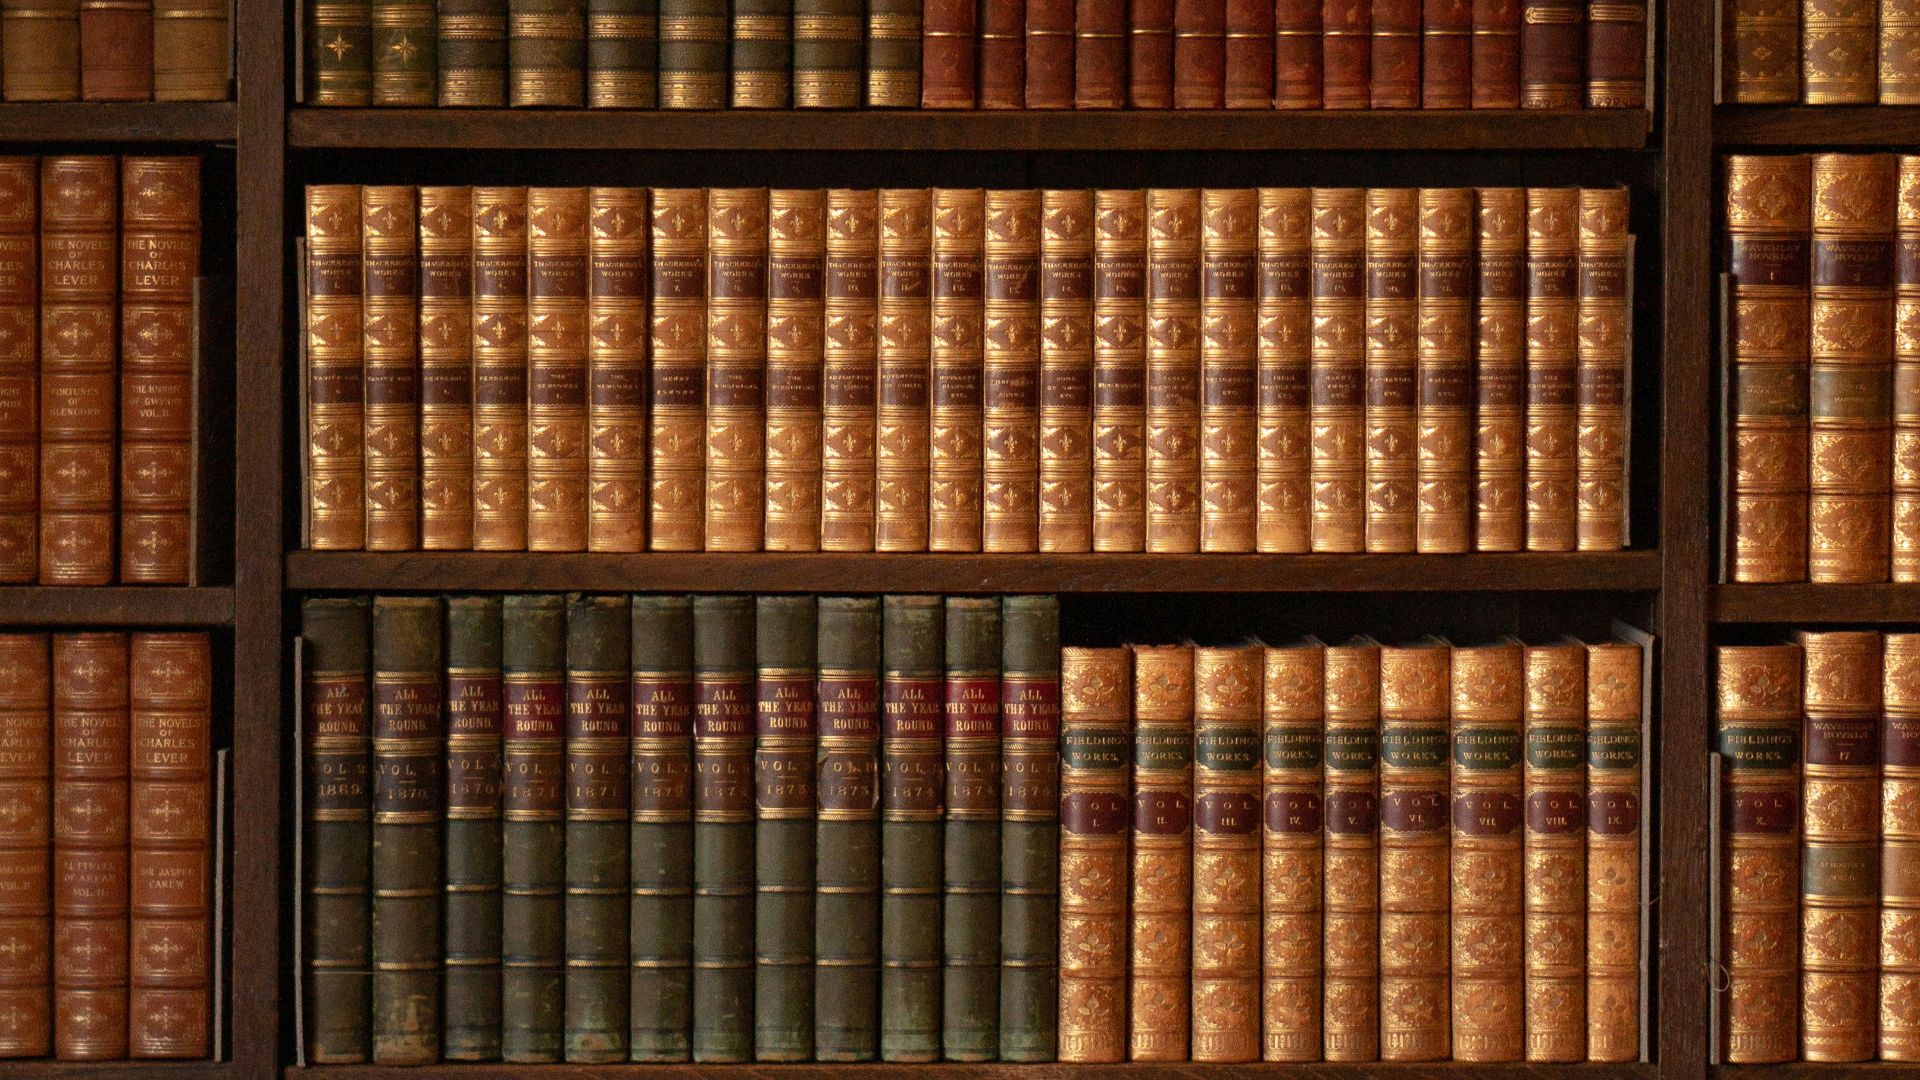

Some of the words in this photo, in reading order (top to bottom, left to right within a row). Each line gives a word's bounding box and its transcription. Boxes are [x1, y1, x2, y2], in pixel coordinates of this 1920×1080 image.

[55, 275, 98, 285] LEVER
[136, 275, 179, 285] LEVER
[327, 686, 349, 698] ALL
[395, 689, 417, 700] ALL
[461, 686, 483, 697] ALL
[523, 690, 545, 700] ALL
[587, 689, 609, 700] ALL
[652, 691, 674, 701] ALL
[713, 690, 735, 701] ALL
[776, 688, 798, 698] ALL
[838, 689, 860, 698] ALL
[902, 689, 924, 699] ALL
[962, 689, 984, 699] ALL
[1020, 690, 1042, 701] ALL
[312, 704, 331, 715] THE
[380, 704, 400, 715] THE
[407, 704, 436, 715] YEAR
[471, 701, 499, 711] YEAR
[509, 704, 529, 715] THE
[536, 704, 561, 715] YEAR
[571, 703, 592, 714] THE
[598, 703, 625, 713] YEAR
[637, 704, 656, 715] THE
[663, 704, 689, 715] YEAR
[698, 704, 719, 715] THE
[725, 704, 751, 715] YEAR
[759, 701, 779, 712] THE
[786, 701, 812, 712] YEAR
[823, 702, 844, 712] THE
[850, 702, 877, 712] YEAR
[886, 703, 906, 713] THE
[912, 703, 939, 713] YEAR
[946, 703, 966, 713] THE
[972, 703, 998, 713] YEAR
[1005, 704, 1025, 714] THE
[1031, 704, 1057, 714] YEAR
[160, 718, 201, 728] NOVELS
[139, 738, 195, 748] CHARLES
[0, 753, 36, 762] EVER
[68, 753, 113, 762] LEVER
[146, 753, 188, 762] LEVER
[319, 784, 362, 796] 1869.
